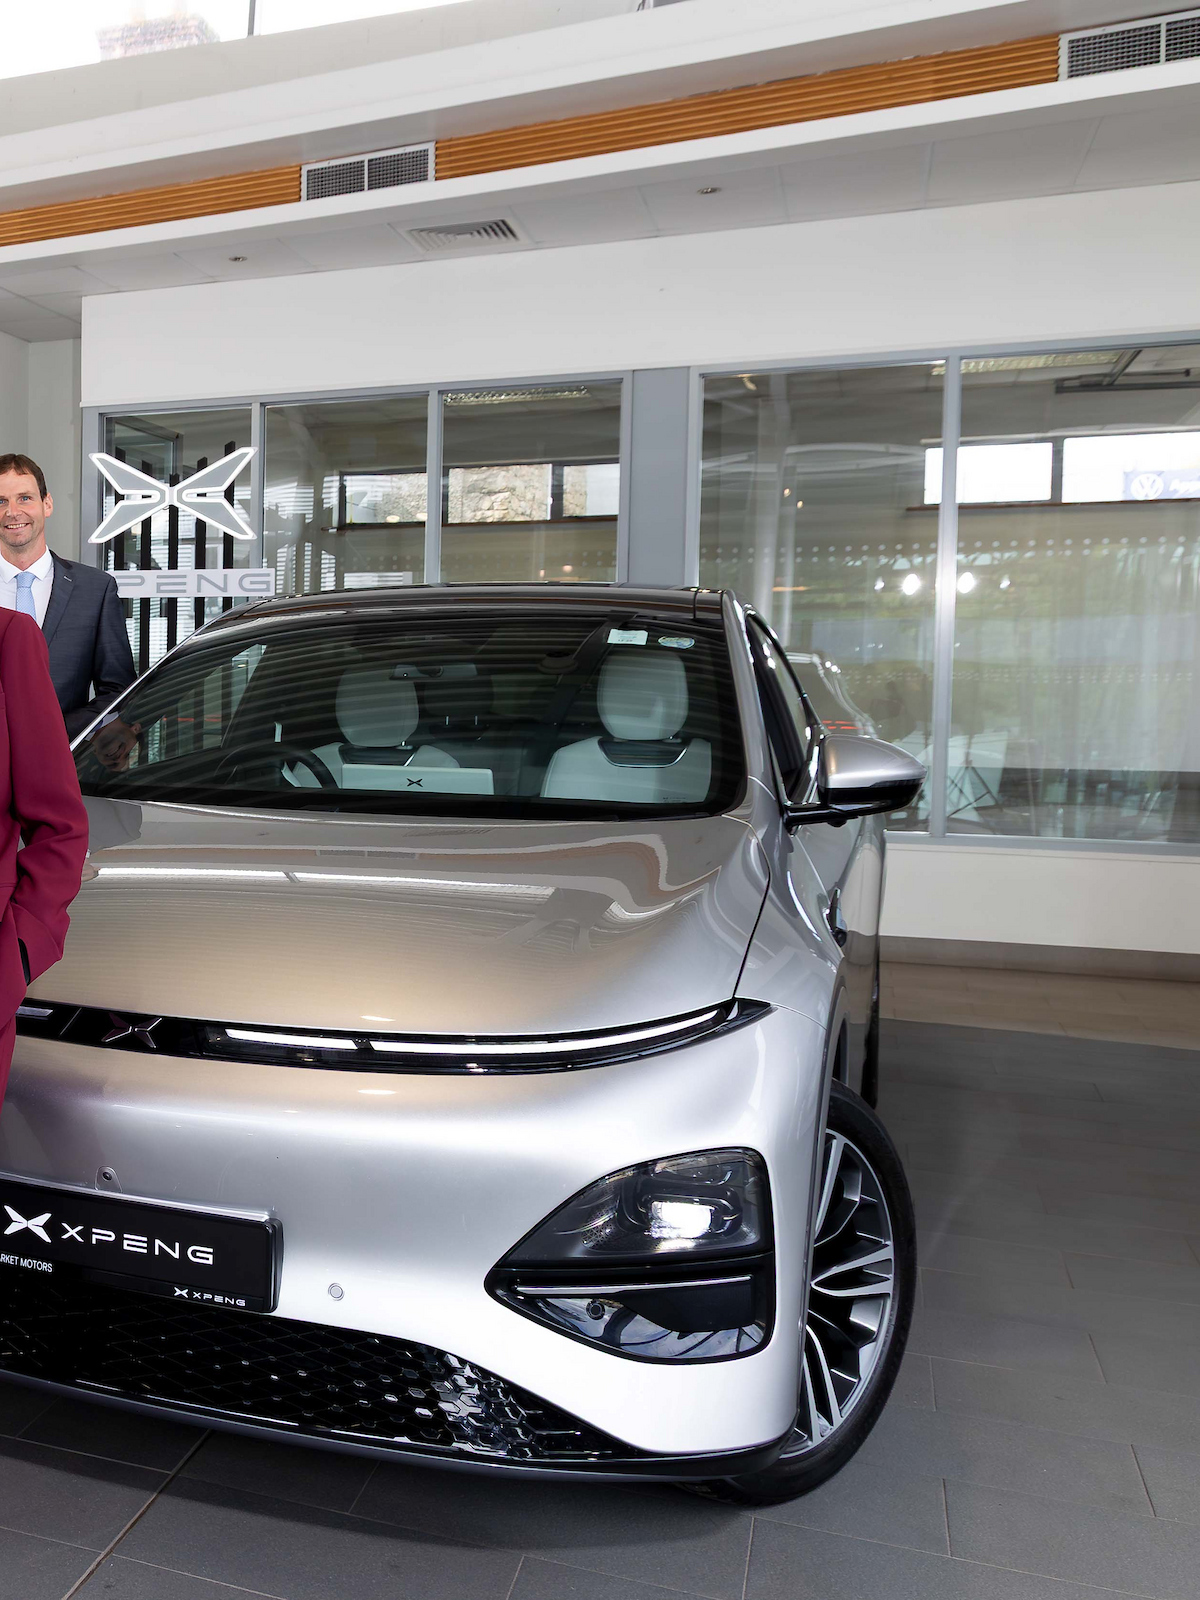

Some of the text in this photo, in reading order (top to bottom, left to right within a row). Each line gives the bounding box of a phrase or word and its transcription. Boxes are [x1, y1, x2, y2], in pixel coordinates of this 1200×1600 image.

[118, 573, 272, 594] PENG
[60, 1222, 214, 1266] XPENG
[20, 1257, 53, 1273] MOTORS
[192, 1291, 246, 1307] XPENG
